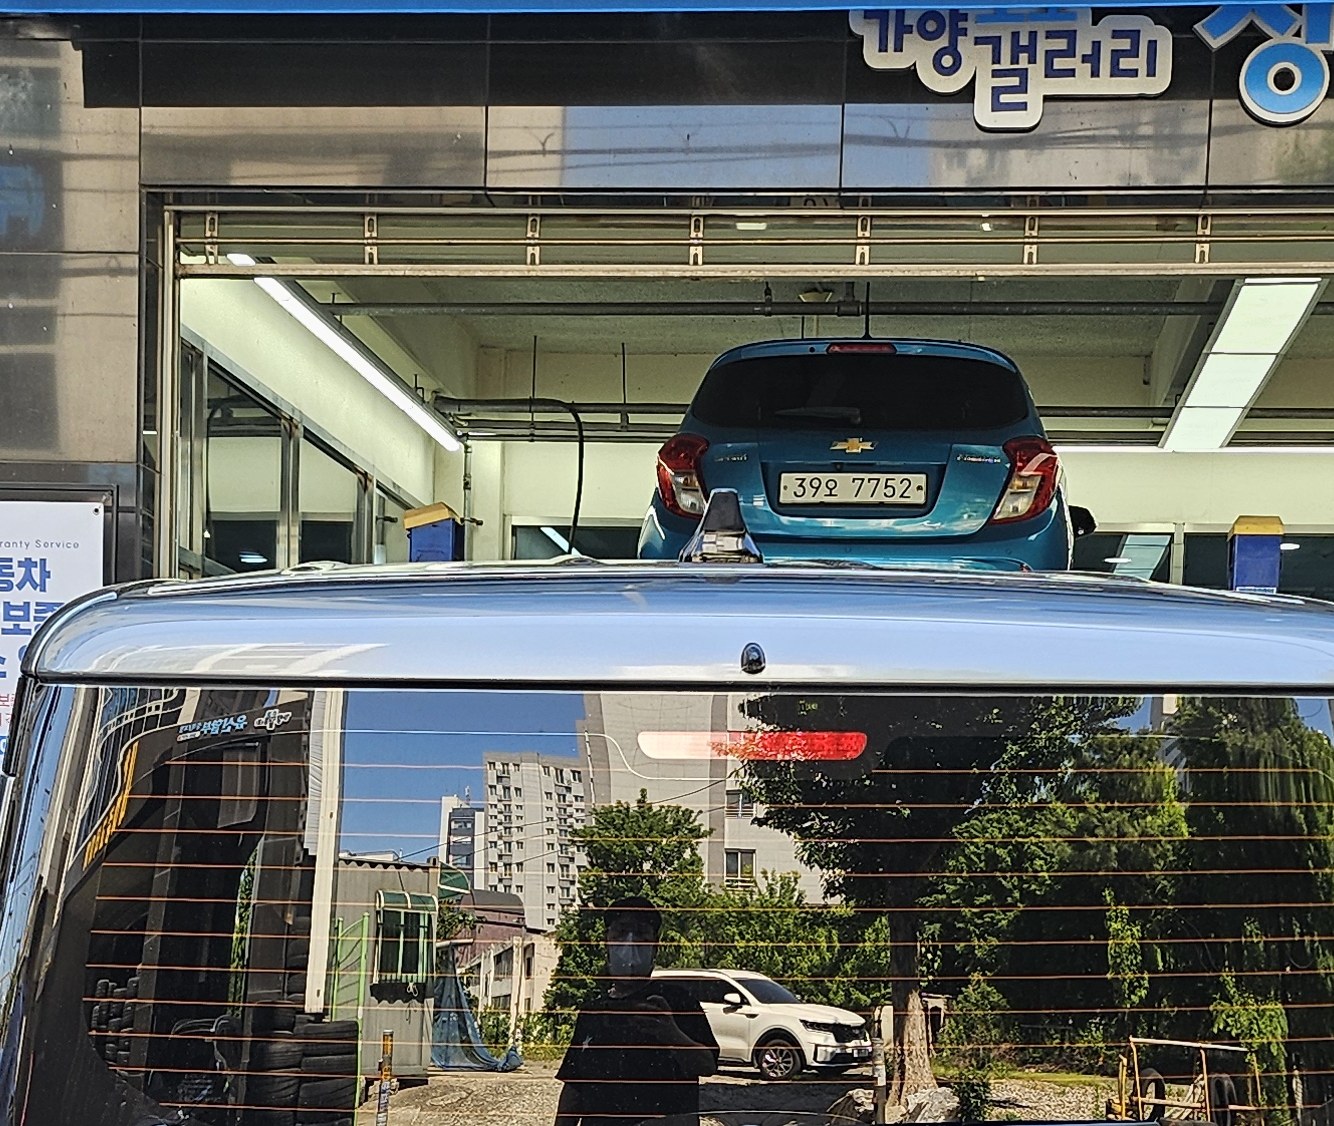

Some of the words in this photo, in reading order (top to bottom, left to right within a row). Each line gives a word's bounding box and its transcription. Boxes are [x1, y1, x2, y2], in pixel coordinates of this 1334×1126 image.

[863, 9, 968, 77] 가양
[973, 29, 1158, 112] 갤러리
[792, 476, 839, 498] 39오
[850, 476, 912, 499] 7752
[34, 539, 80, 550] Service
